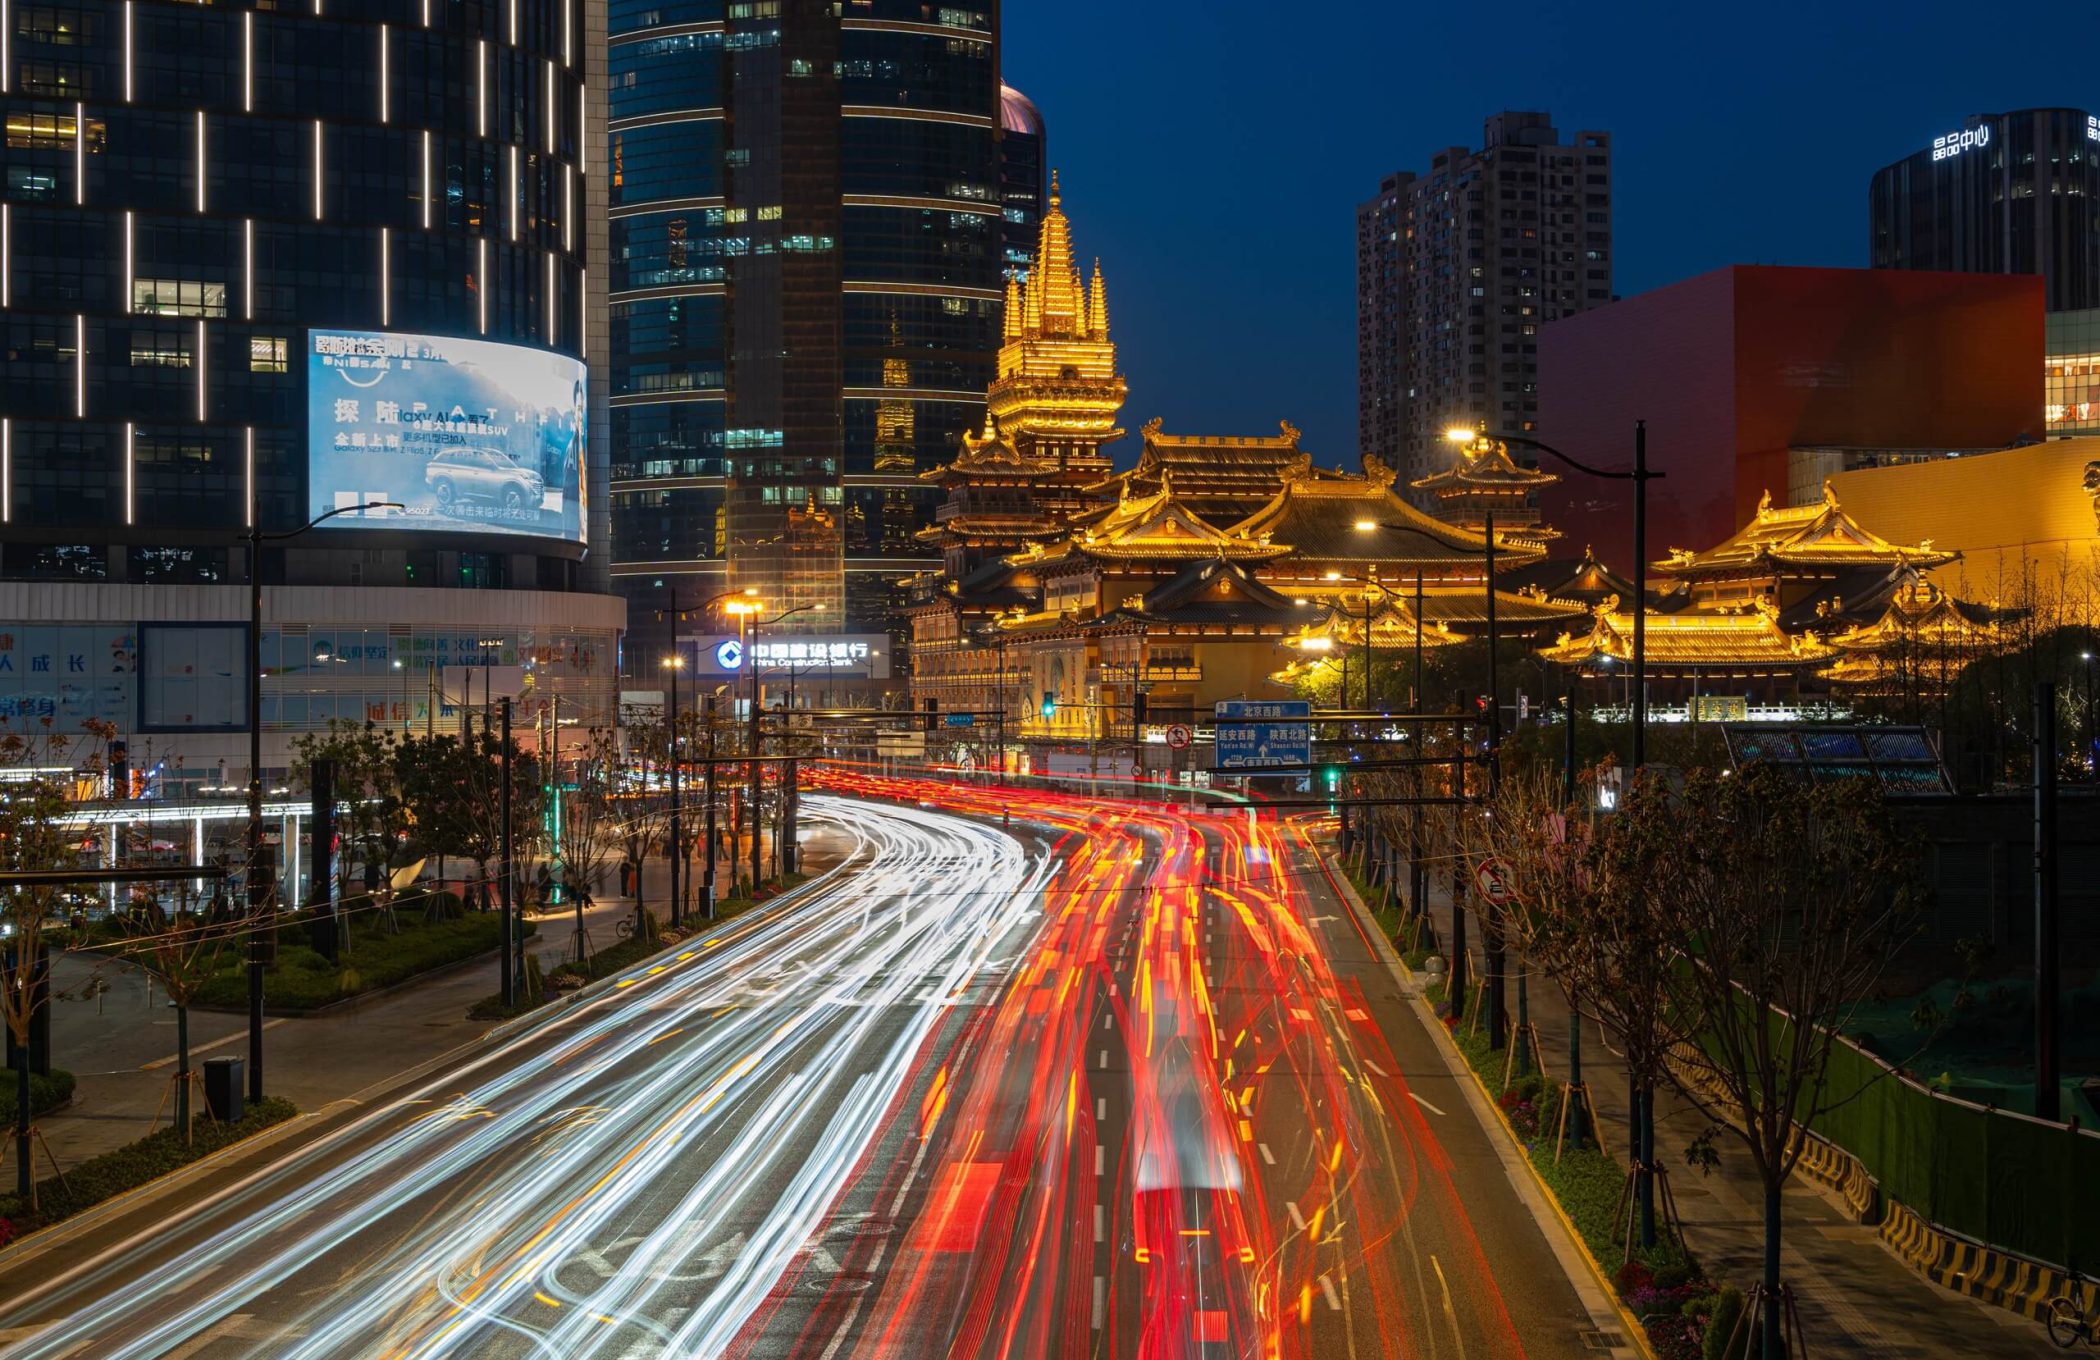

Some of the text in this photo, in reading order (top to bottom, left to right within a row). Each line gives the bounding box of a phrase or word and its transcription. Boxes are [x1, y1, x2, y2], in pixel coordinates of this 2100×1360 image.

[2087, 116, 2100, 141] 晶
[1932, 124, 1989, 161] 晶品中心
[750, 643, 868, 659] 中国建设银行
[778, 658, 830, 668] Construction
[831, 658, 853, 667] Bank
[1244, 705, 1281, 718] 北京西路
[1218, 729, 1307, 741] 延安西路 陕西北路
